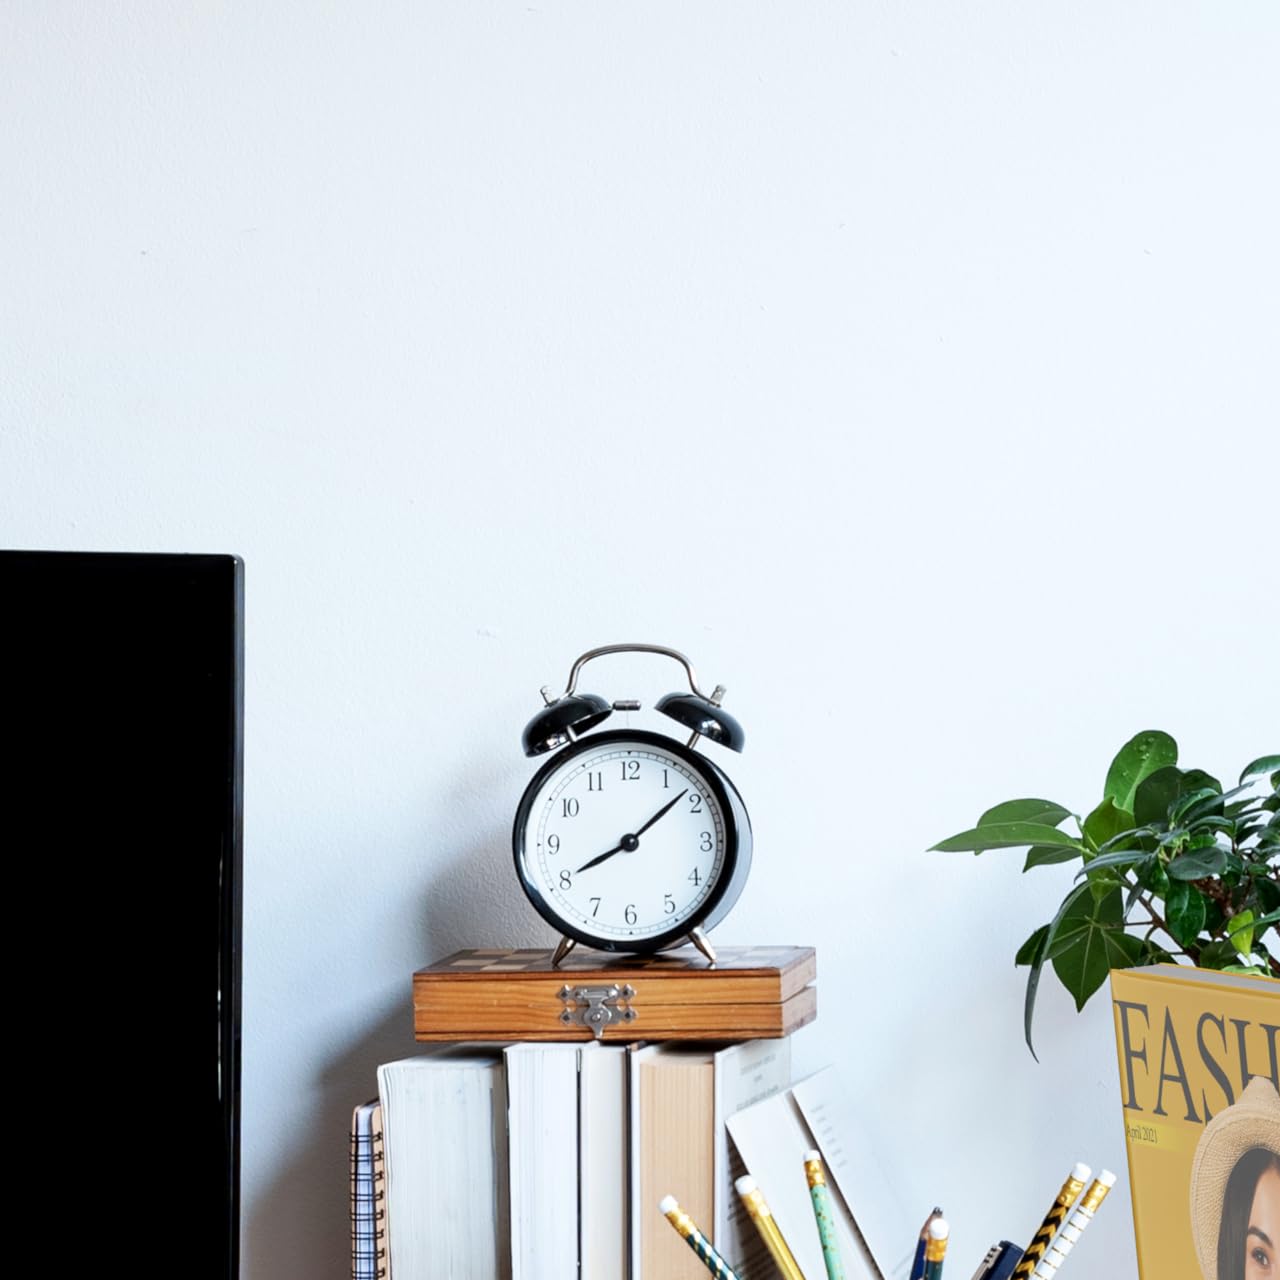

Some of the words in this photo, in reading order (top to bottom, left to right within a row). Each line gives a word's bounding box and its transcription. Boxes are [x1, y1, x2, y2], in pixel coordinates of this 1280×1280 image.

[620, 760, 641, 780] 12
[662, 769, 670, 789] 1
[587, 772, 604, 791] 11
[561, 797, 580, 817] 10
[689, 794, 702, 814] 2
[547, 834, 560, 855] 9
[699, 831, 713, 852] 3
[558, 869, 573, 890] 8
[687, 867, 702, 886] 4
[589, 897, 601, 917] 7
[663, 894, 676, 914] 5
[624, 904, 638, 925] 6
